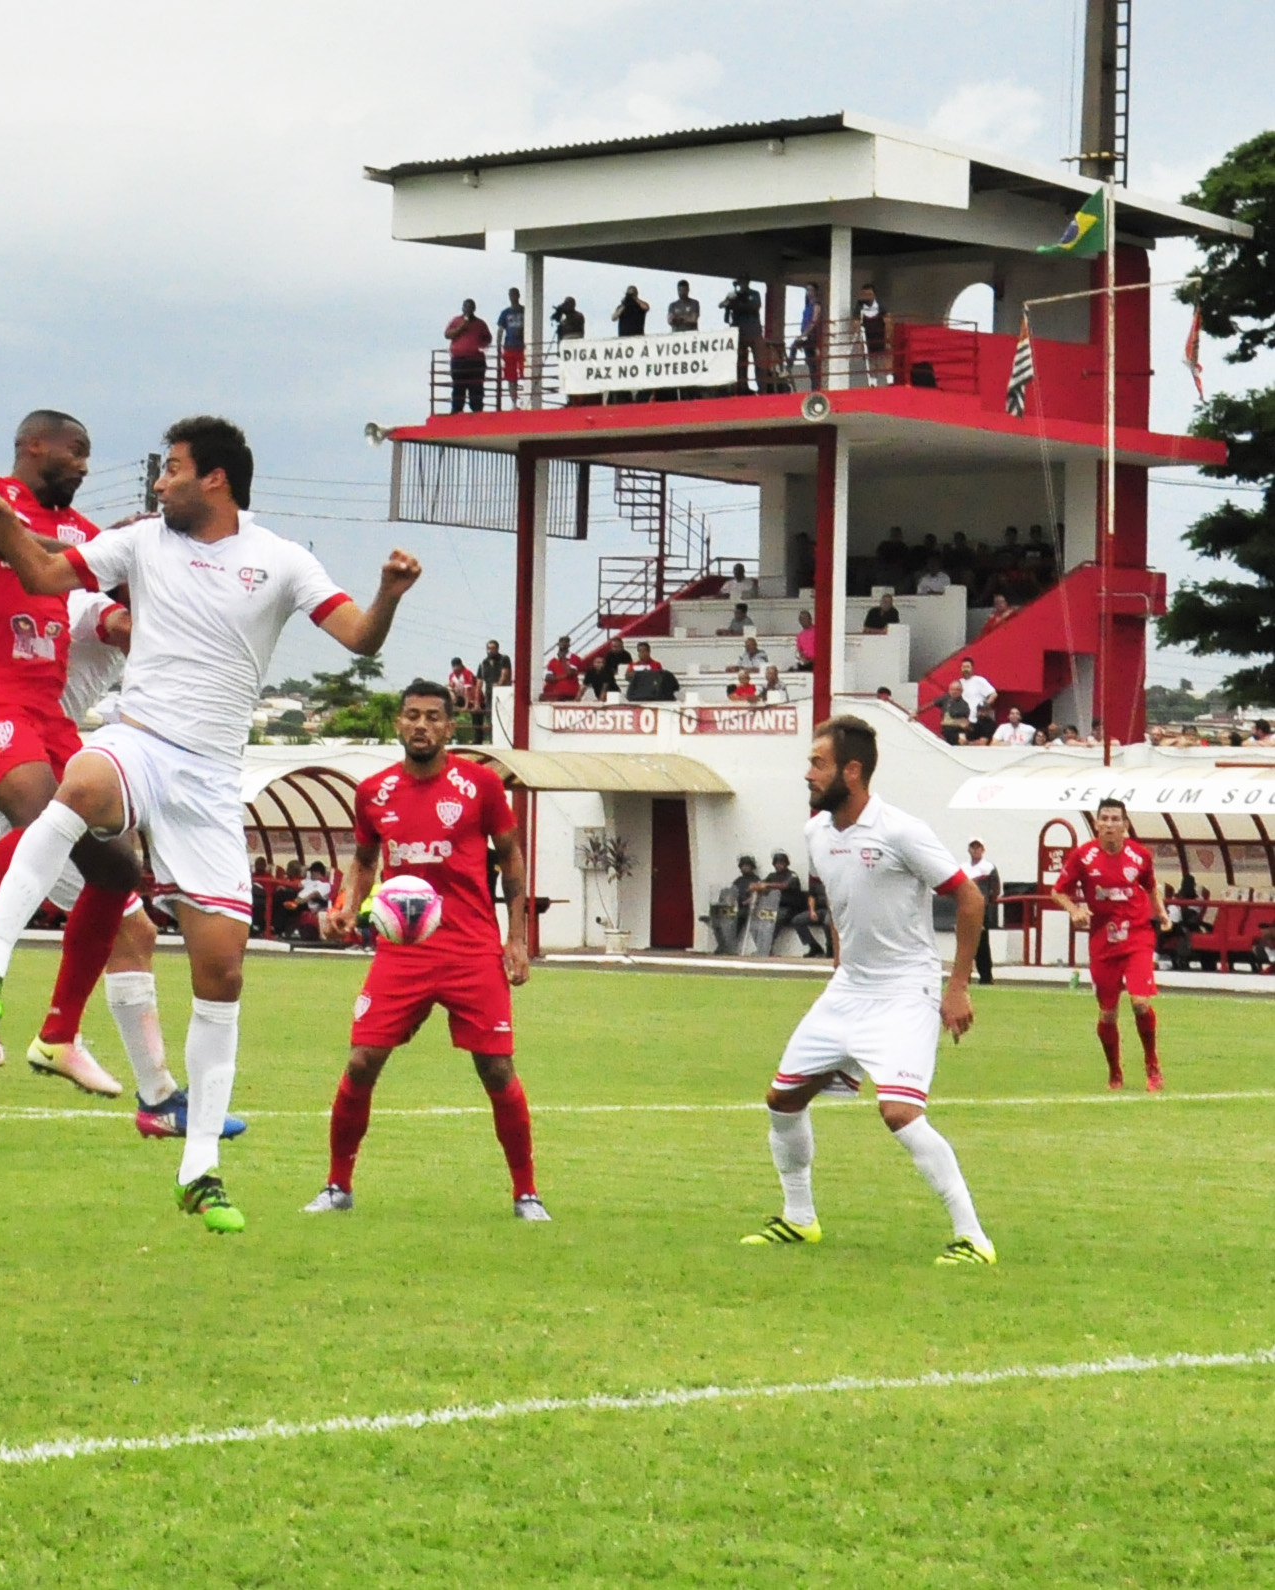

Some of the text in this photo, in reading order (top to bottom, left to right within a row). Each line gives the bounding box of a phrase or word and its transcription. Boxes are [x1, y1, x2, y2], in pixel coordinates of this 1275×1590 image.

[563, 347, 597, 361] DIGA
[656, 336, 735, 356] VIOLÊNCIA
[586, 359, 709, 380] PAZ NO FUTEBOL
[554, 708, 634, 731] NOROESTE
[714, 707, 796, 731] VISITANTE
[1058, 787, 1136, 802] SEJA
[1156, 788, 1203, 804] UM
